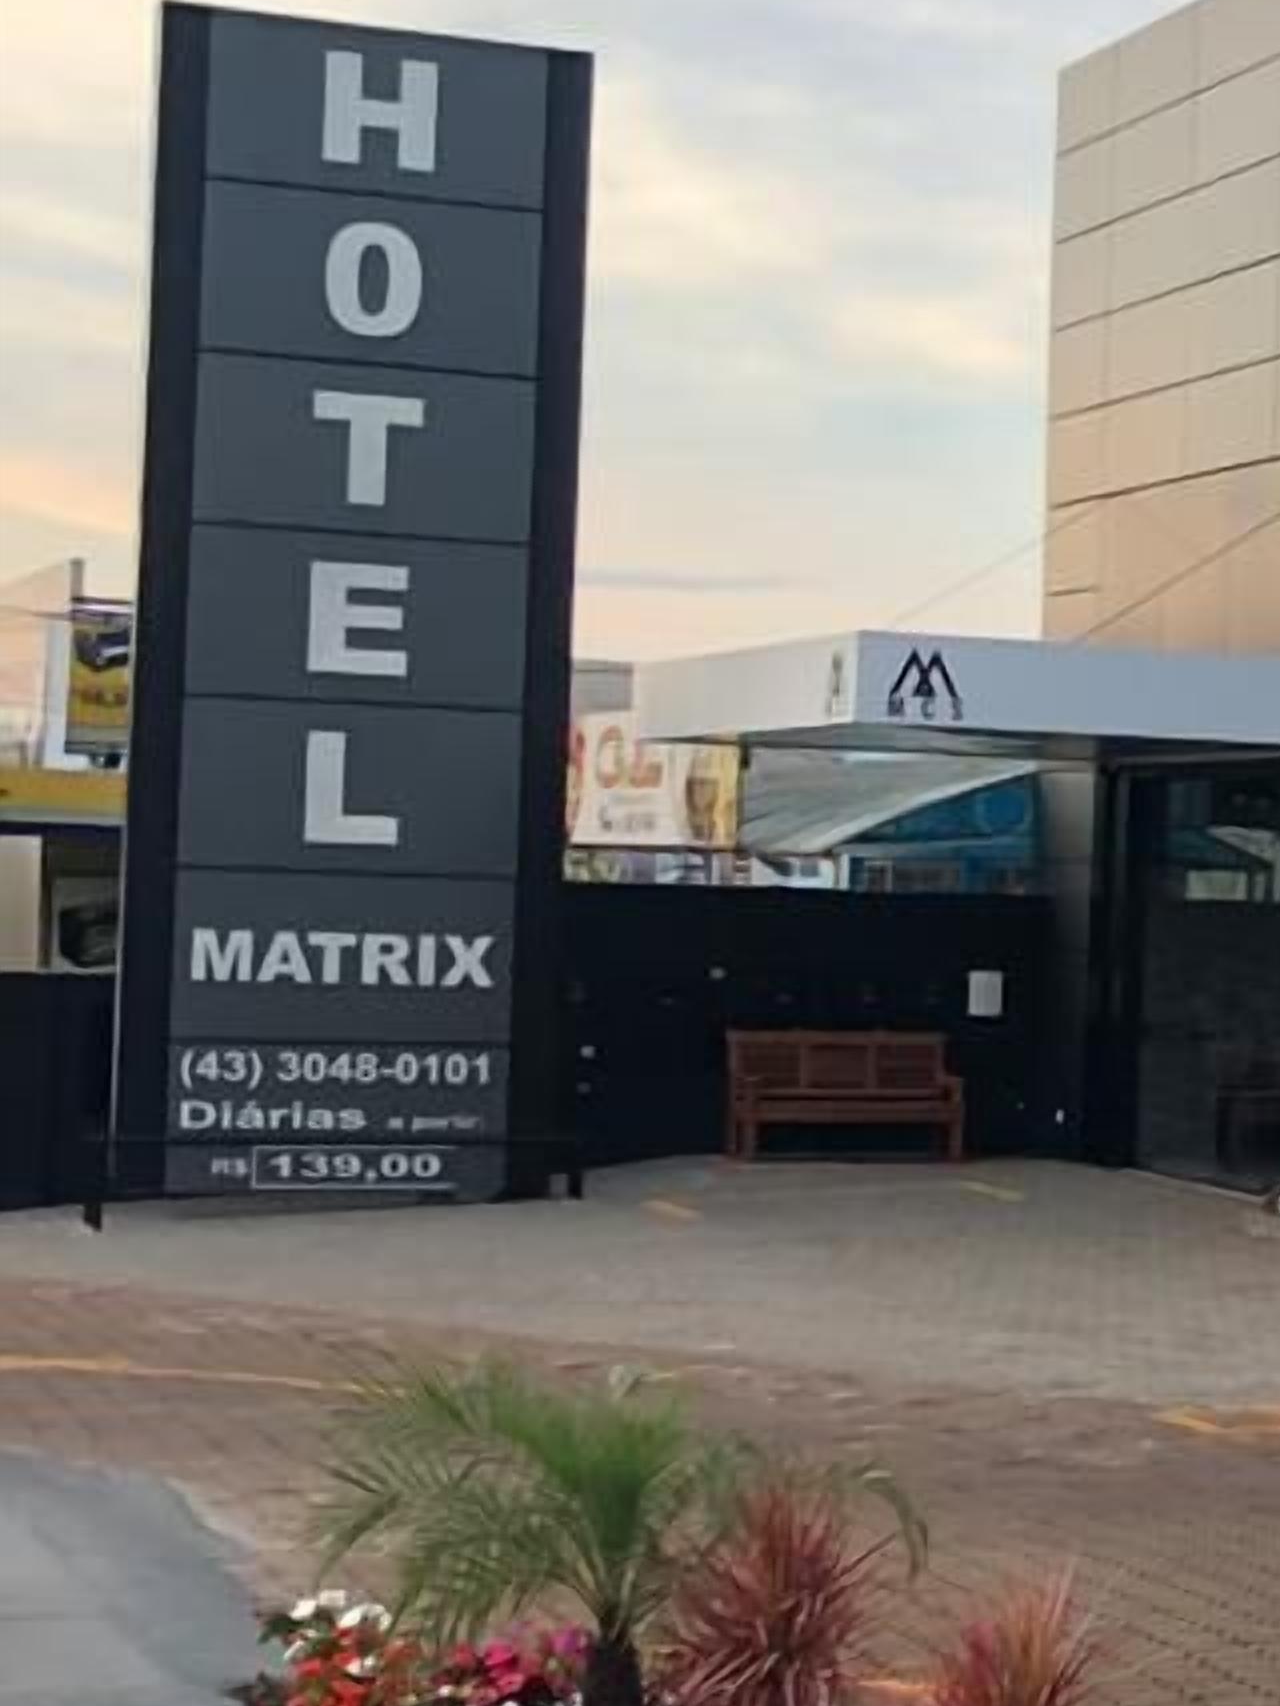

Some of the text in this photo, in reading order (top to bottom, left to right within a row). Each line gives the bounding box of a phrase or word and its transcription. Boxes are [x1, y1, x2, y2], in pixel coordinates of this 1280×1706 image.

[304, 50, 439, 846] HOTEL
[190, 927, 495, 988] MATRIX
[180, 1048, 490, 1090] (43) 3048-0101
[178, 1099, 367, 1131] Diárias
